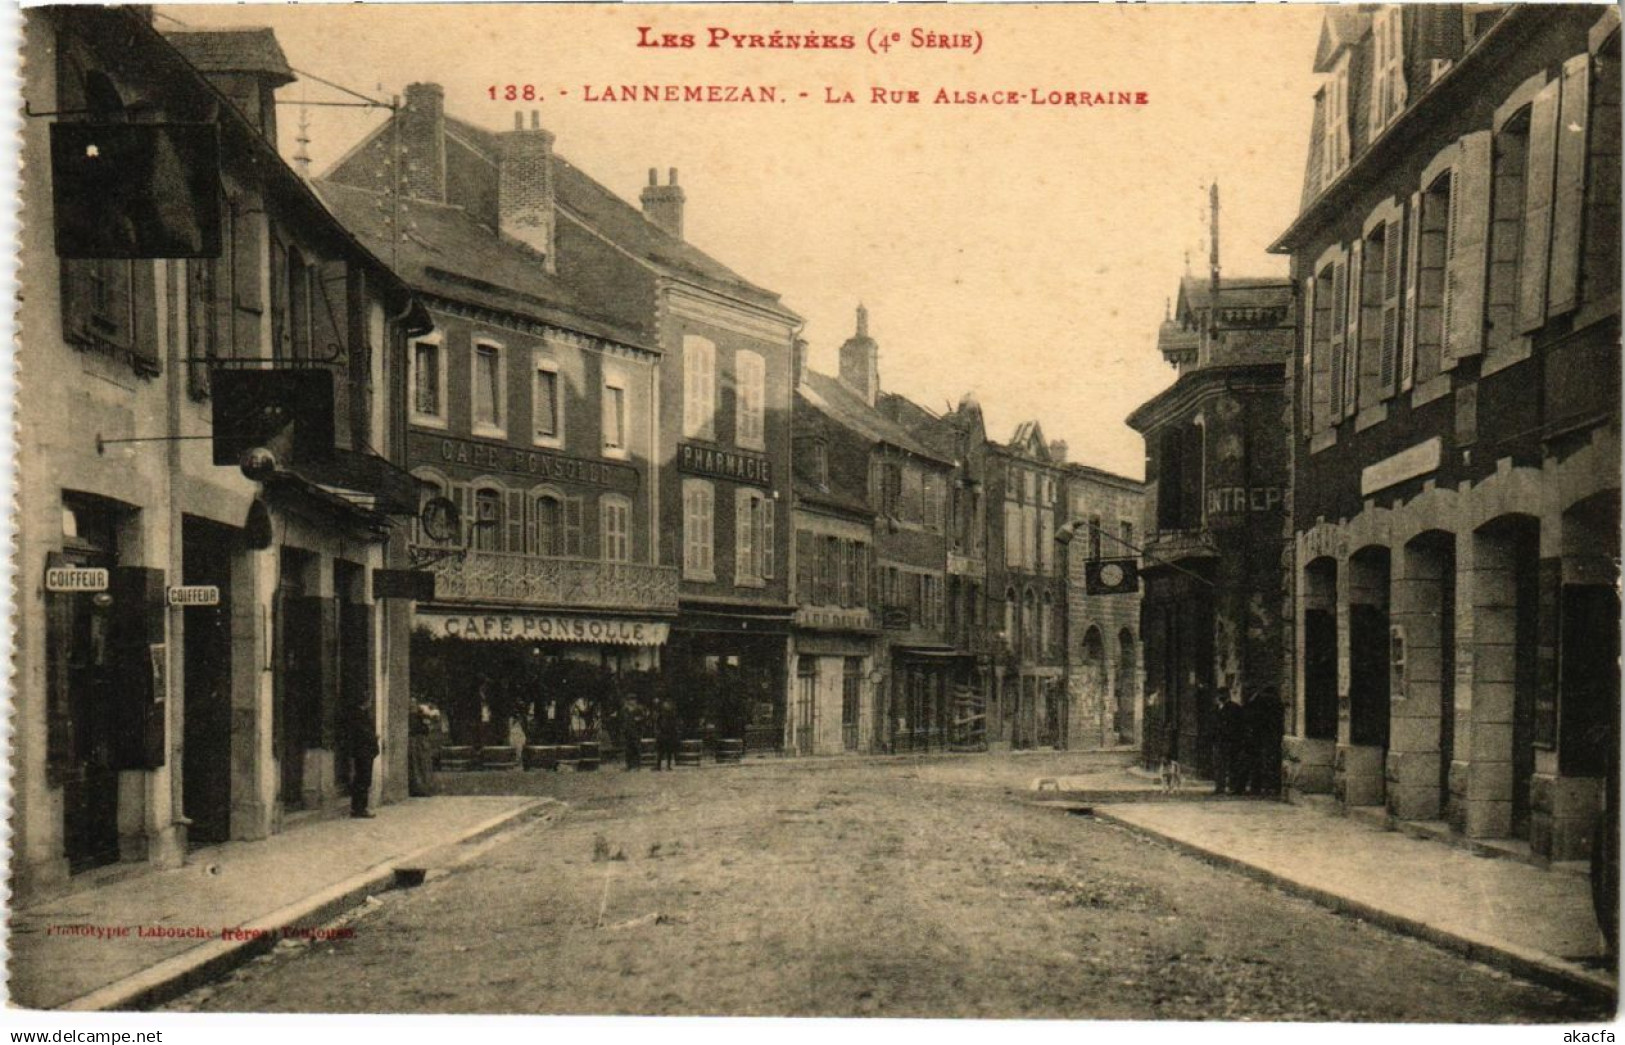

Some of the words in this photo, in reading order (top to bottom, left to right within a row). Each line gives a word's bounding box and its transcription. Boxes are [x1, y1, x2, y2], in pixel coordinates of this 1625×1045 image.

[683, 446, 770, 482] PHARMACIE
[49, 570, 105, 588] COIFFEUR
[171, 588, 217, 603] COIFFEUR
[523, 617, 644, 640] PONSOLLE
